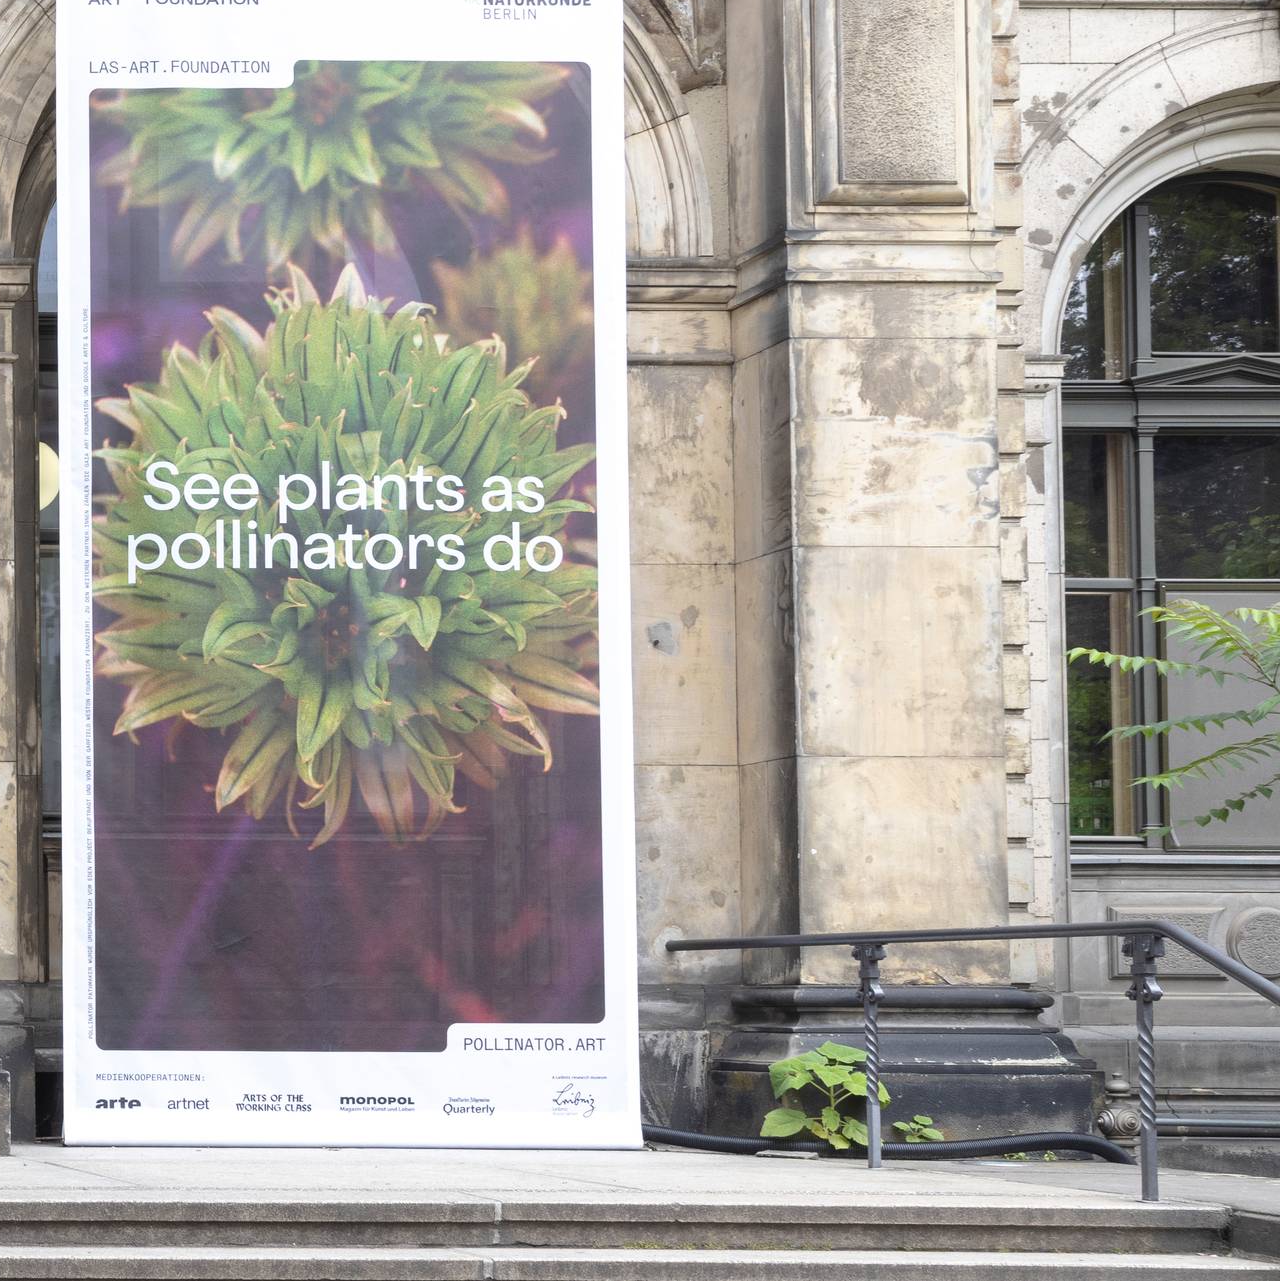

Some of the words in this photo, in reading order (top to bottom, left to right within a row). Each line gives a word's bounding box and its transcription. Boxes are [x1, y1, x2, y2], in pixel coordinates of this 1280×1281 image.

[483, 8, 537, 20] BERLIN
[89, 60, 270, 73] LAS-ART.FOUNDATION
[143, 460, 259, 511] See
[279, 460, 465, 524] plants
[481, 473, 545, 514] as
[127, 520, 466, 584] pollinators
[483, 523, 564, 572] do
[463, 1037, 606, 1051] POLLINATOR.ART
[96, 1073, 206, 1081] MEDIENKOOPERATIONEN:
[96, 1097, 141, 1109] arte
[167, 1098, 210, 1110] artnet
[243, 1094, 267, 1102] ARTS
[270, 1094, 283, 1102] OF
[287, 1094, 304, 1102] THE
[236, 1103, 281, 1112] WORKING
[284, 1103, 312, 1112] CLASS
[443, 1103, 495, 1115] Quarterly
